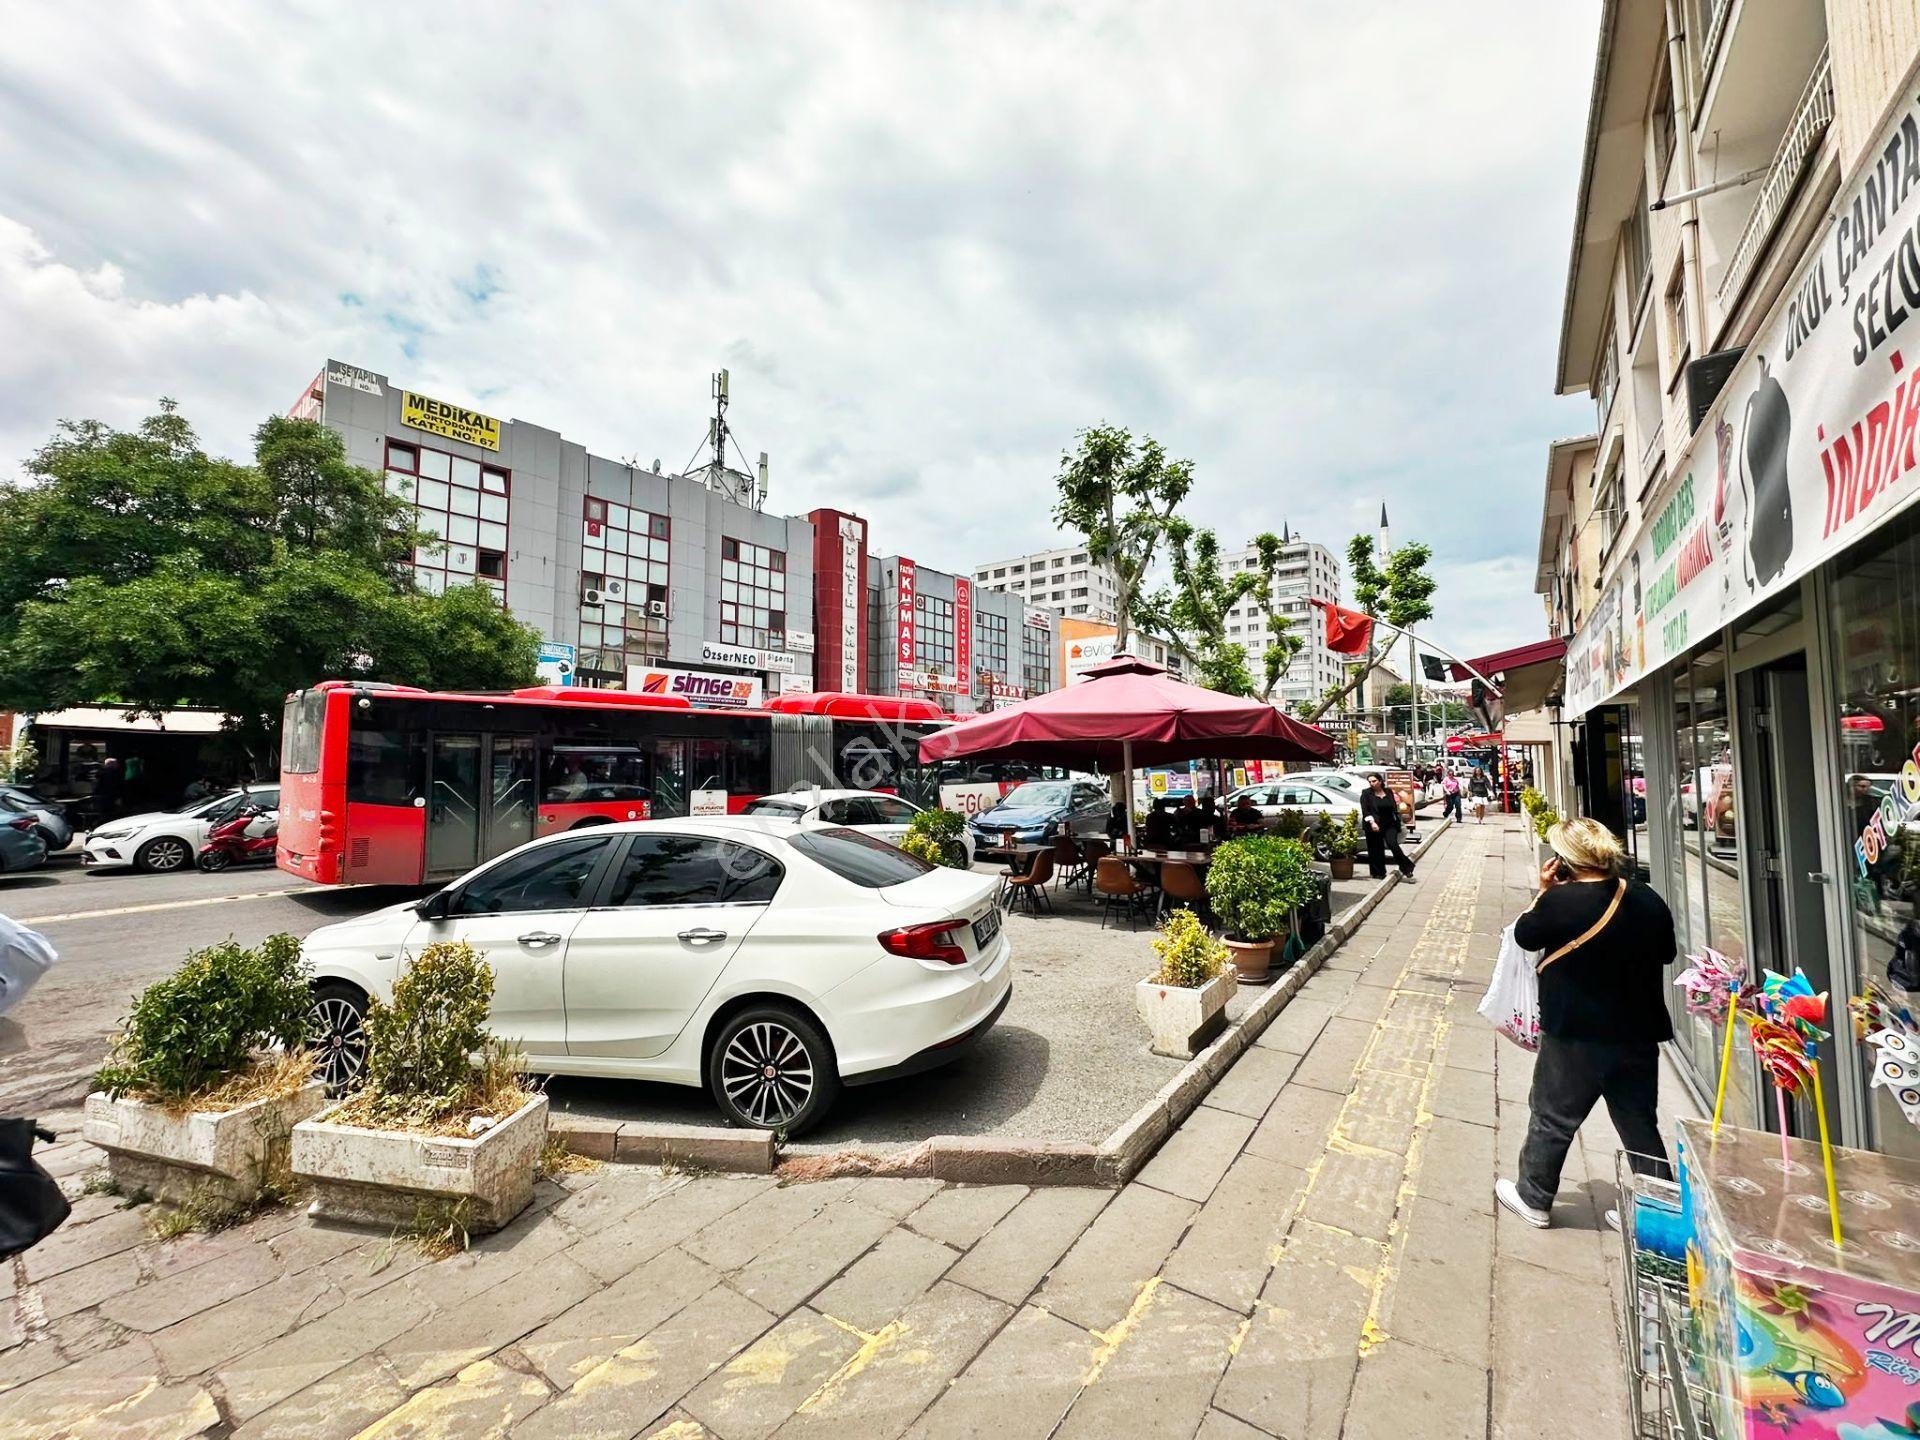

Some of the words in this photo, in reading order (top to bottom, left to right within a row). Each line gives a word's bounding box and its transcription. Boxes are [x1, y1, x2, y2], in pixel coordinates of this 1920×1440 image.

[1786, 254, 1833, 363] OKUL
[1837, 94, 1920, 307] ÇANTA
[1852, 215, 1920, 367] SEZO
[480, 437, 495, 447] 67
[702, 646, 757, 665] ÖzserNEO
